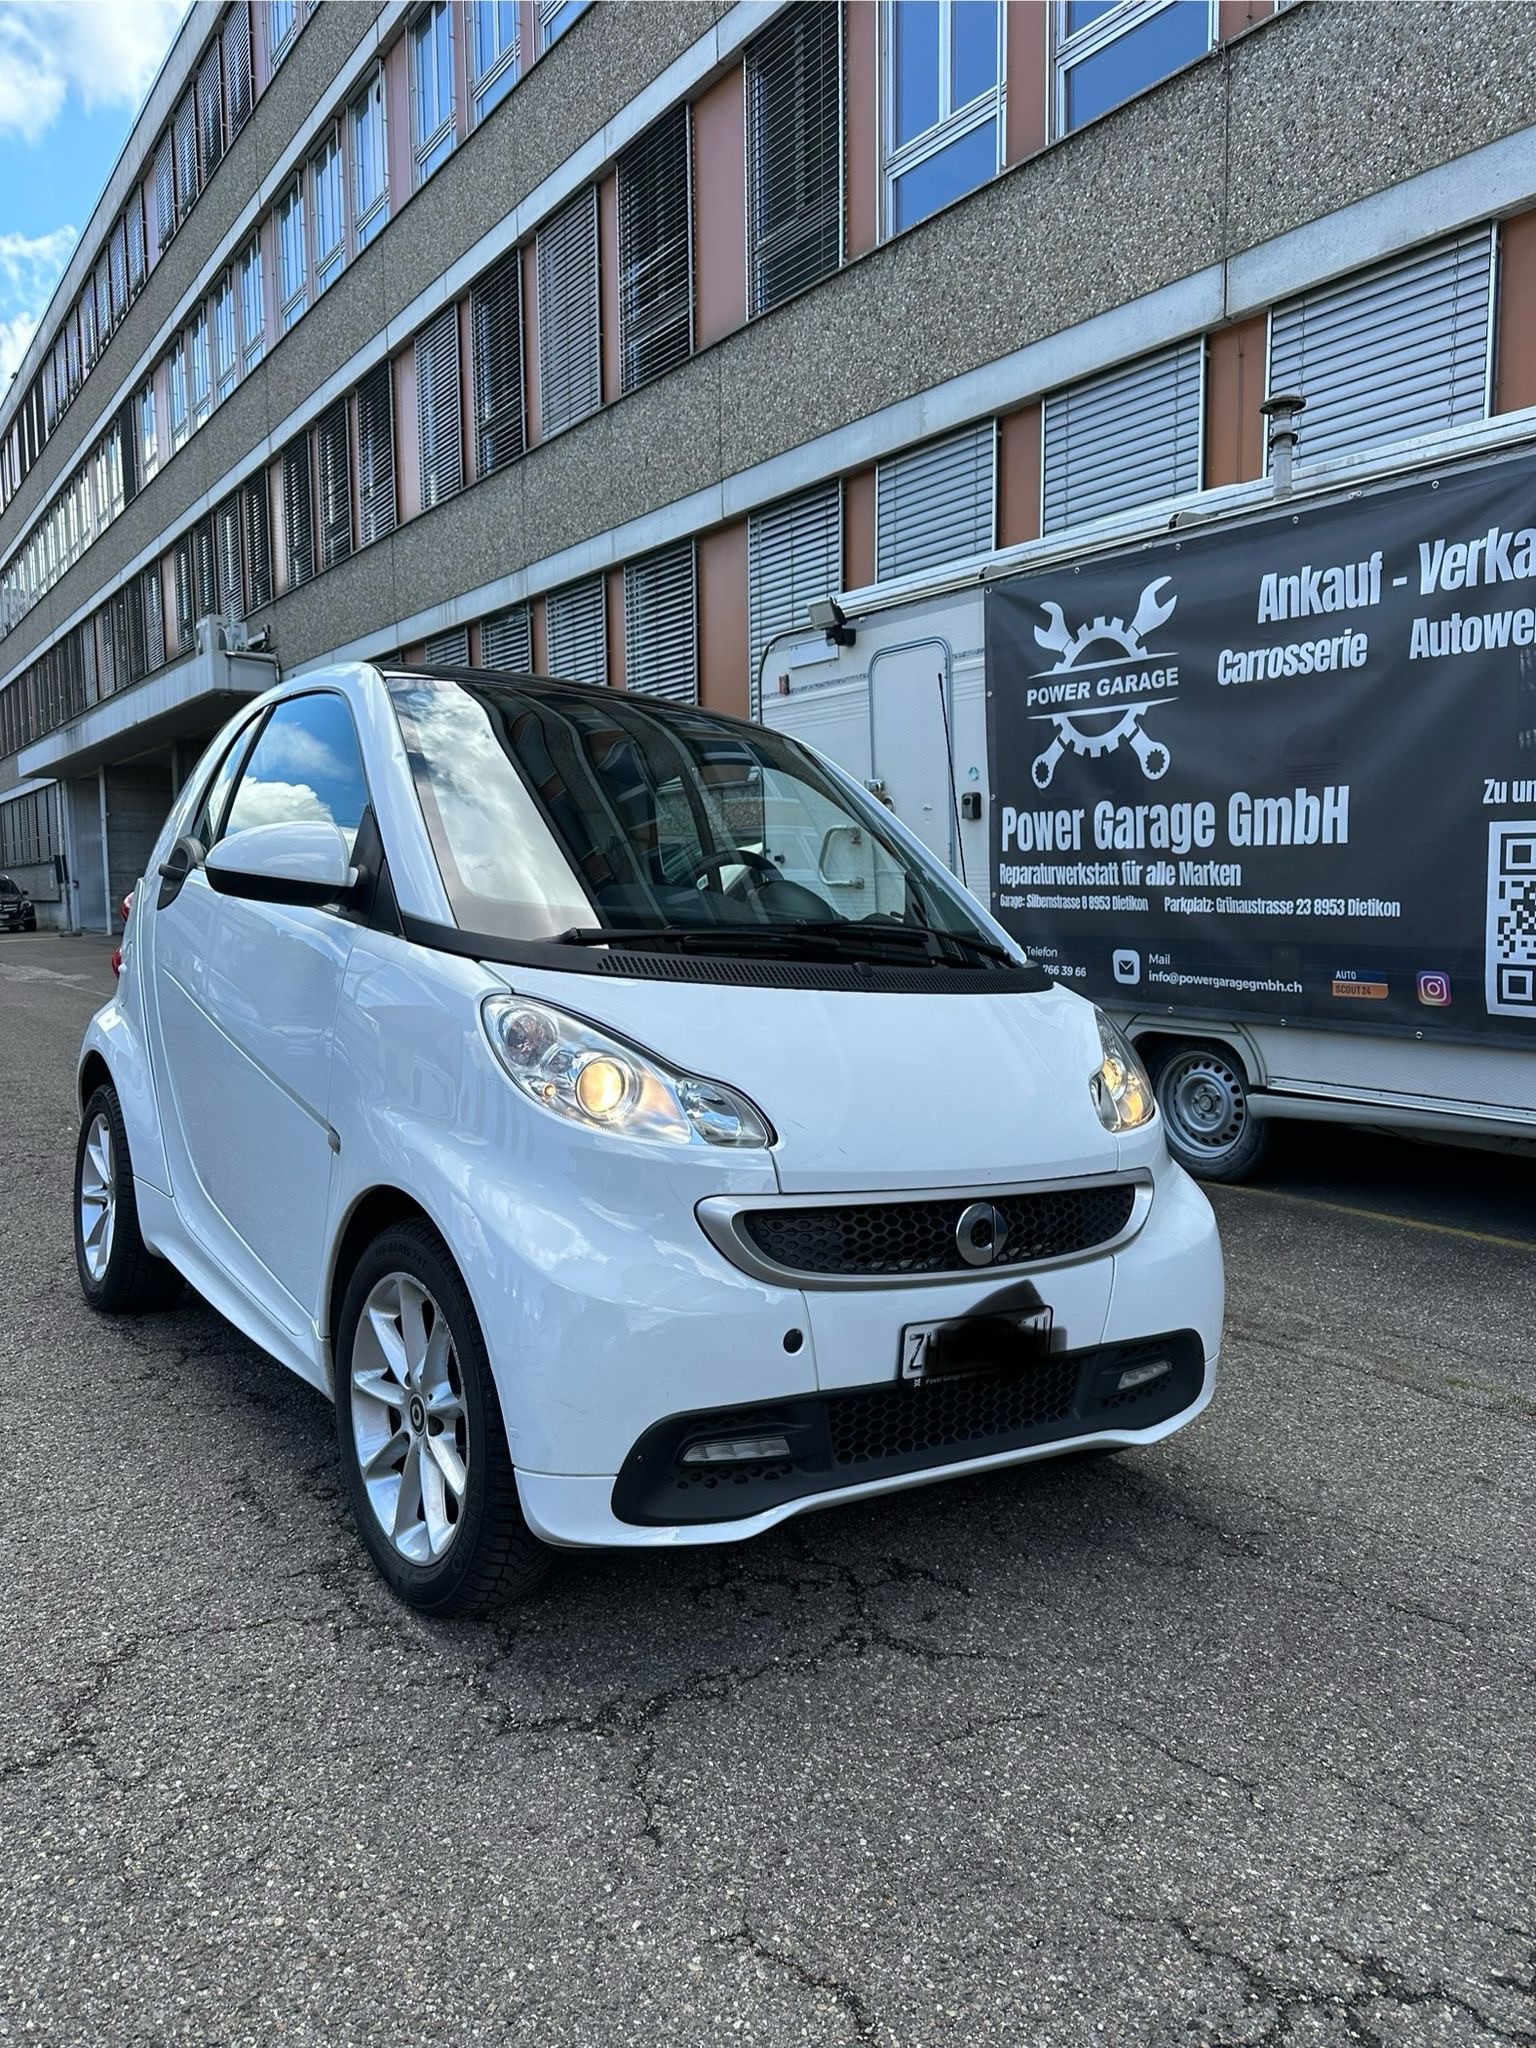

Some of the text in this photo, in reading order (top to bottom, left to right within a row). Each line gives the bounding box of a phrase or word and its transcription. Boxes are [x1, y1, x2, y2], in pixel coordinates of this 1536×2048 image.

[1257, 551, 1383, 624] Ankauf
[1409, 607, 1536, 660] Autowe
[1217, 629, 1368, 686] Carrosserie
[1027, 667, 1179, 707] POWER GARAGE
[1483, 778, 1508, 804] Zu
[1002, 785, 1350, 855] Power Garage GmbH
[1000, 860, 1242, 888] Reparaturwerkstatt für alle Marken
[1000, 894, 1025, 910] Garage:
[1082, 896, 1087, 910] 8
[1088, 896, 1110, 911] 8953
[1112, 897, 1149, 912] Dietikon
[1164, 896, 1401, 918] Parkplatz: Grünaustrasse 23 8953 Dietikon
[1026, 945, 1058, 958] Telefon
[1149, 953, 1171, 966] Mail
[1061, 965, 1074, 977] 39
[1075, 966, 1087, 978] 66
[1149, 971, 1303, 993] info@powergaragegmbh.ch
[1335, 969, 1358, 981] AUTO
